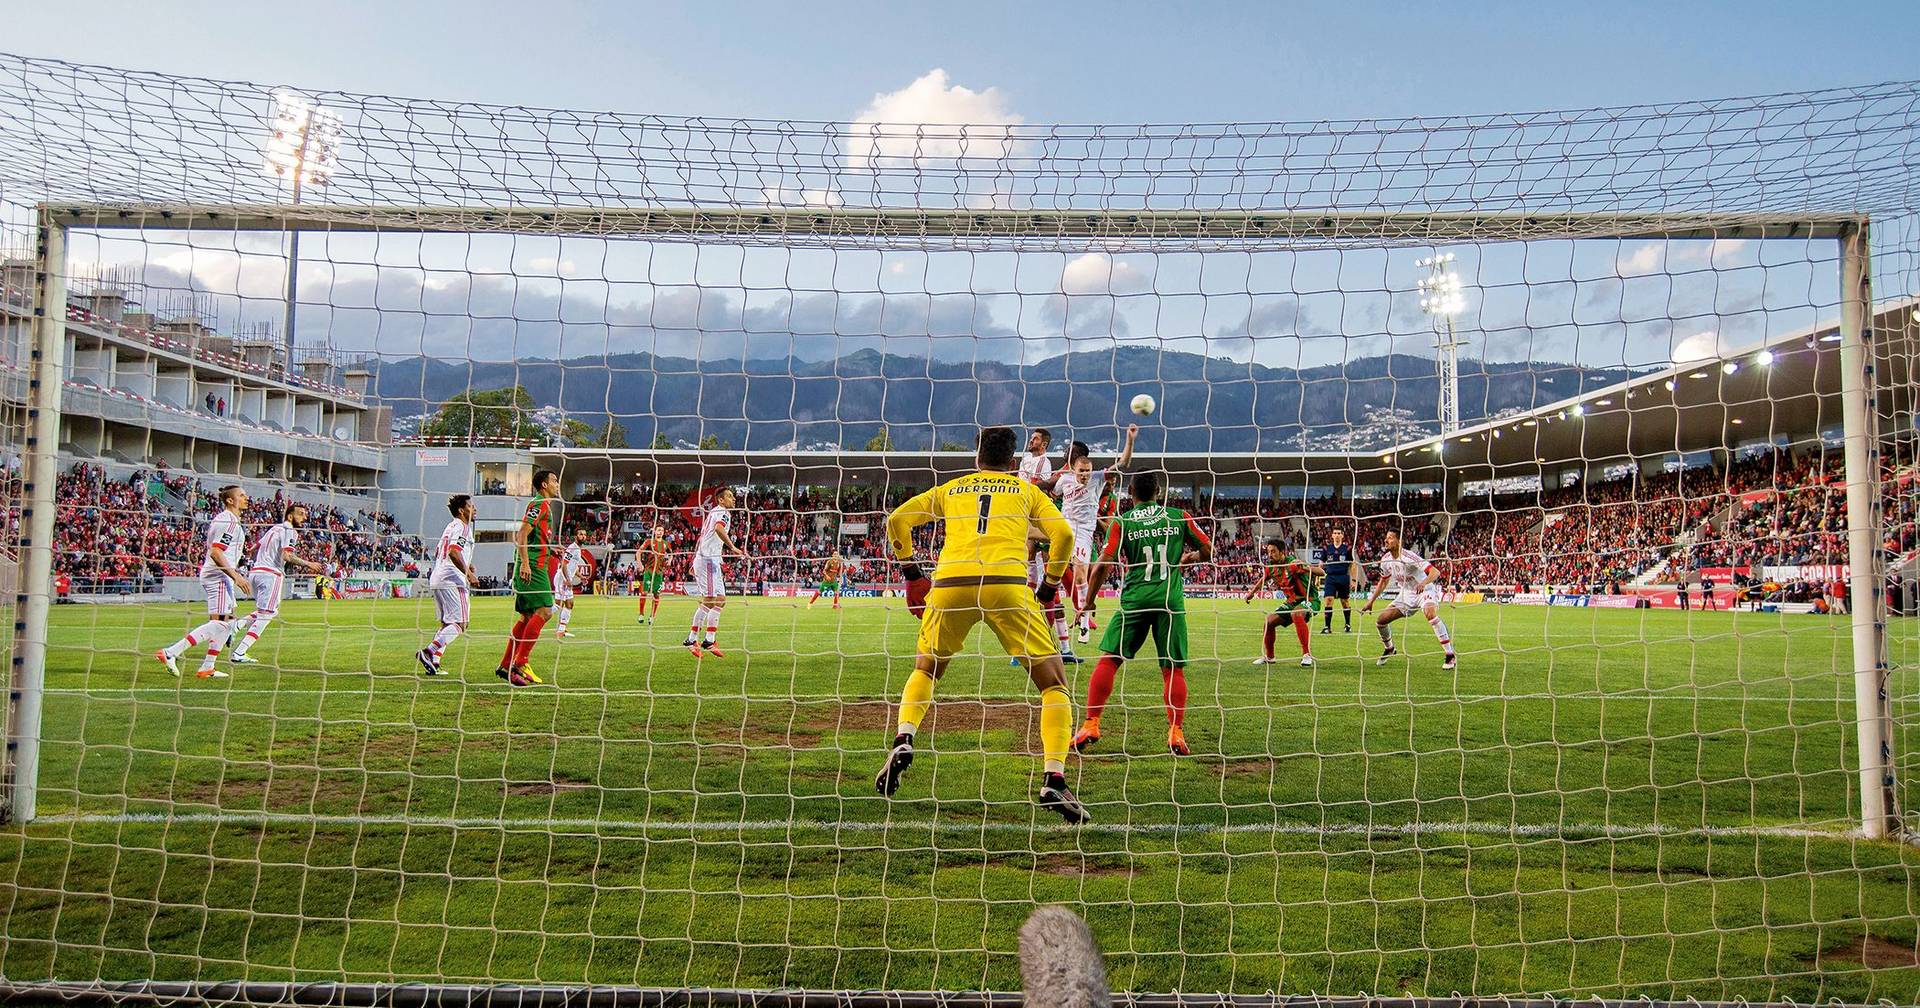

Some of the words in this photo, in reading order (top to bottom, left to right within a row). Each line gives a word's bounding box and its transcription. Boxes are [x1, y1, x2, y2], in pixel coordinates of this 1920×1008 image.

[949, 486, 1006, 495] EDERSON
[977, 493, 992, 534] 1
[1128, 530, 1150, 541] ÉBER
[1151, 527, 1179, 537] BESSA
[1142, 544, 1167, 581] 11
[1217, 592, 1241, 600] SUPER
[1241, 592, 1260, 600] BOK
